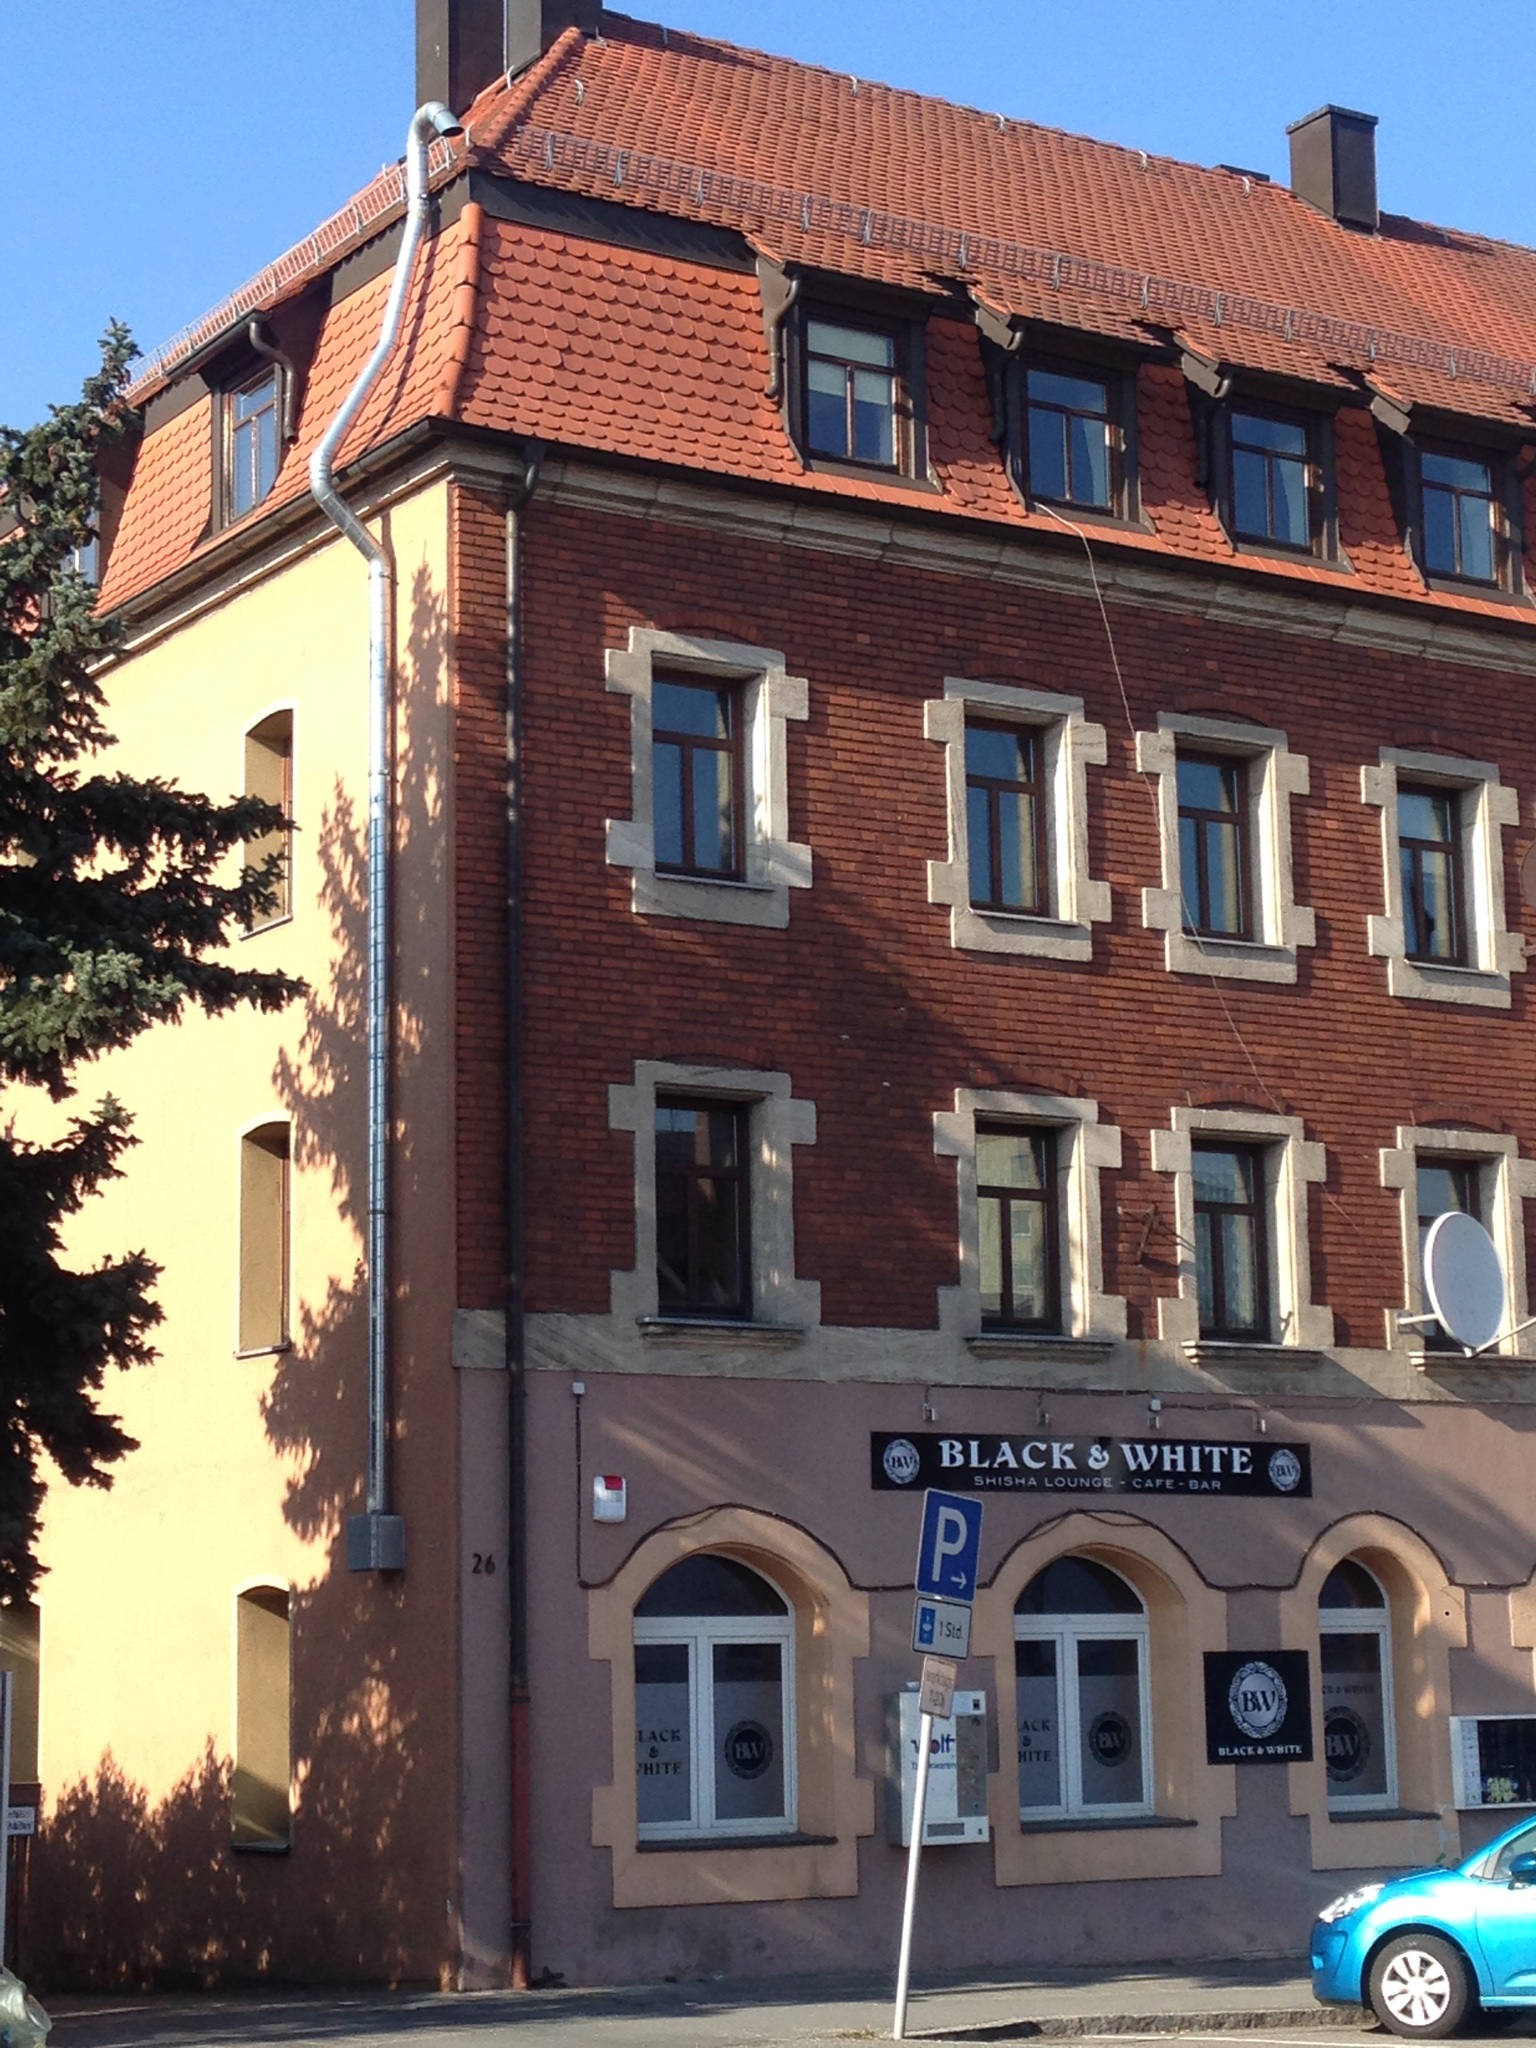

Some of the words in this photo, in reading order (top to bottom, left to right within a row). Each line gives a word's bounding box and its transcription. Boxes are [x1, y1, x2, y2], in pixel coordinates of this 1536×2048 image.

[938, 1439, 1078, 1470] BLACK
[1087, 1444, 1110, 1470] &
[1118, 1443, 1253, 1475] WHITE
[973, 1475, 1038, 1487] SHISHA
[1044, 1476, 1113, 1488] LOUNGE
[931, 1505, 968, 1582] P
[472, 1553, 496, 1575] 26
[938, 1621, 943, 1637] 1
[944, 1622, 964, 1640] Std.
[1240, 1689, 1276, 1713] BW
[1218, 1746, 1254, 1756] BLACK
[1256, 1746, 1265, 1755] &
[1266, 1744, 1303, 1755] WHITE
